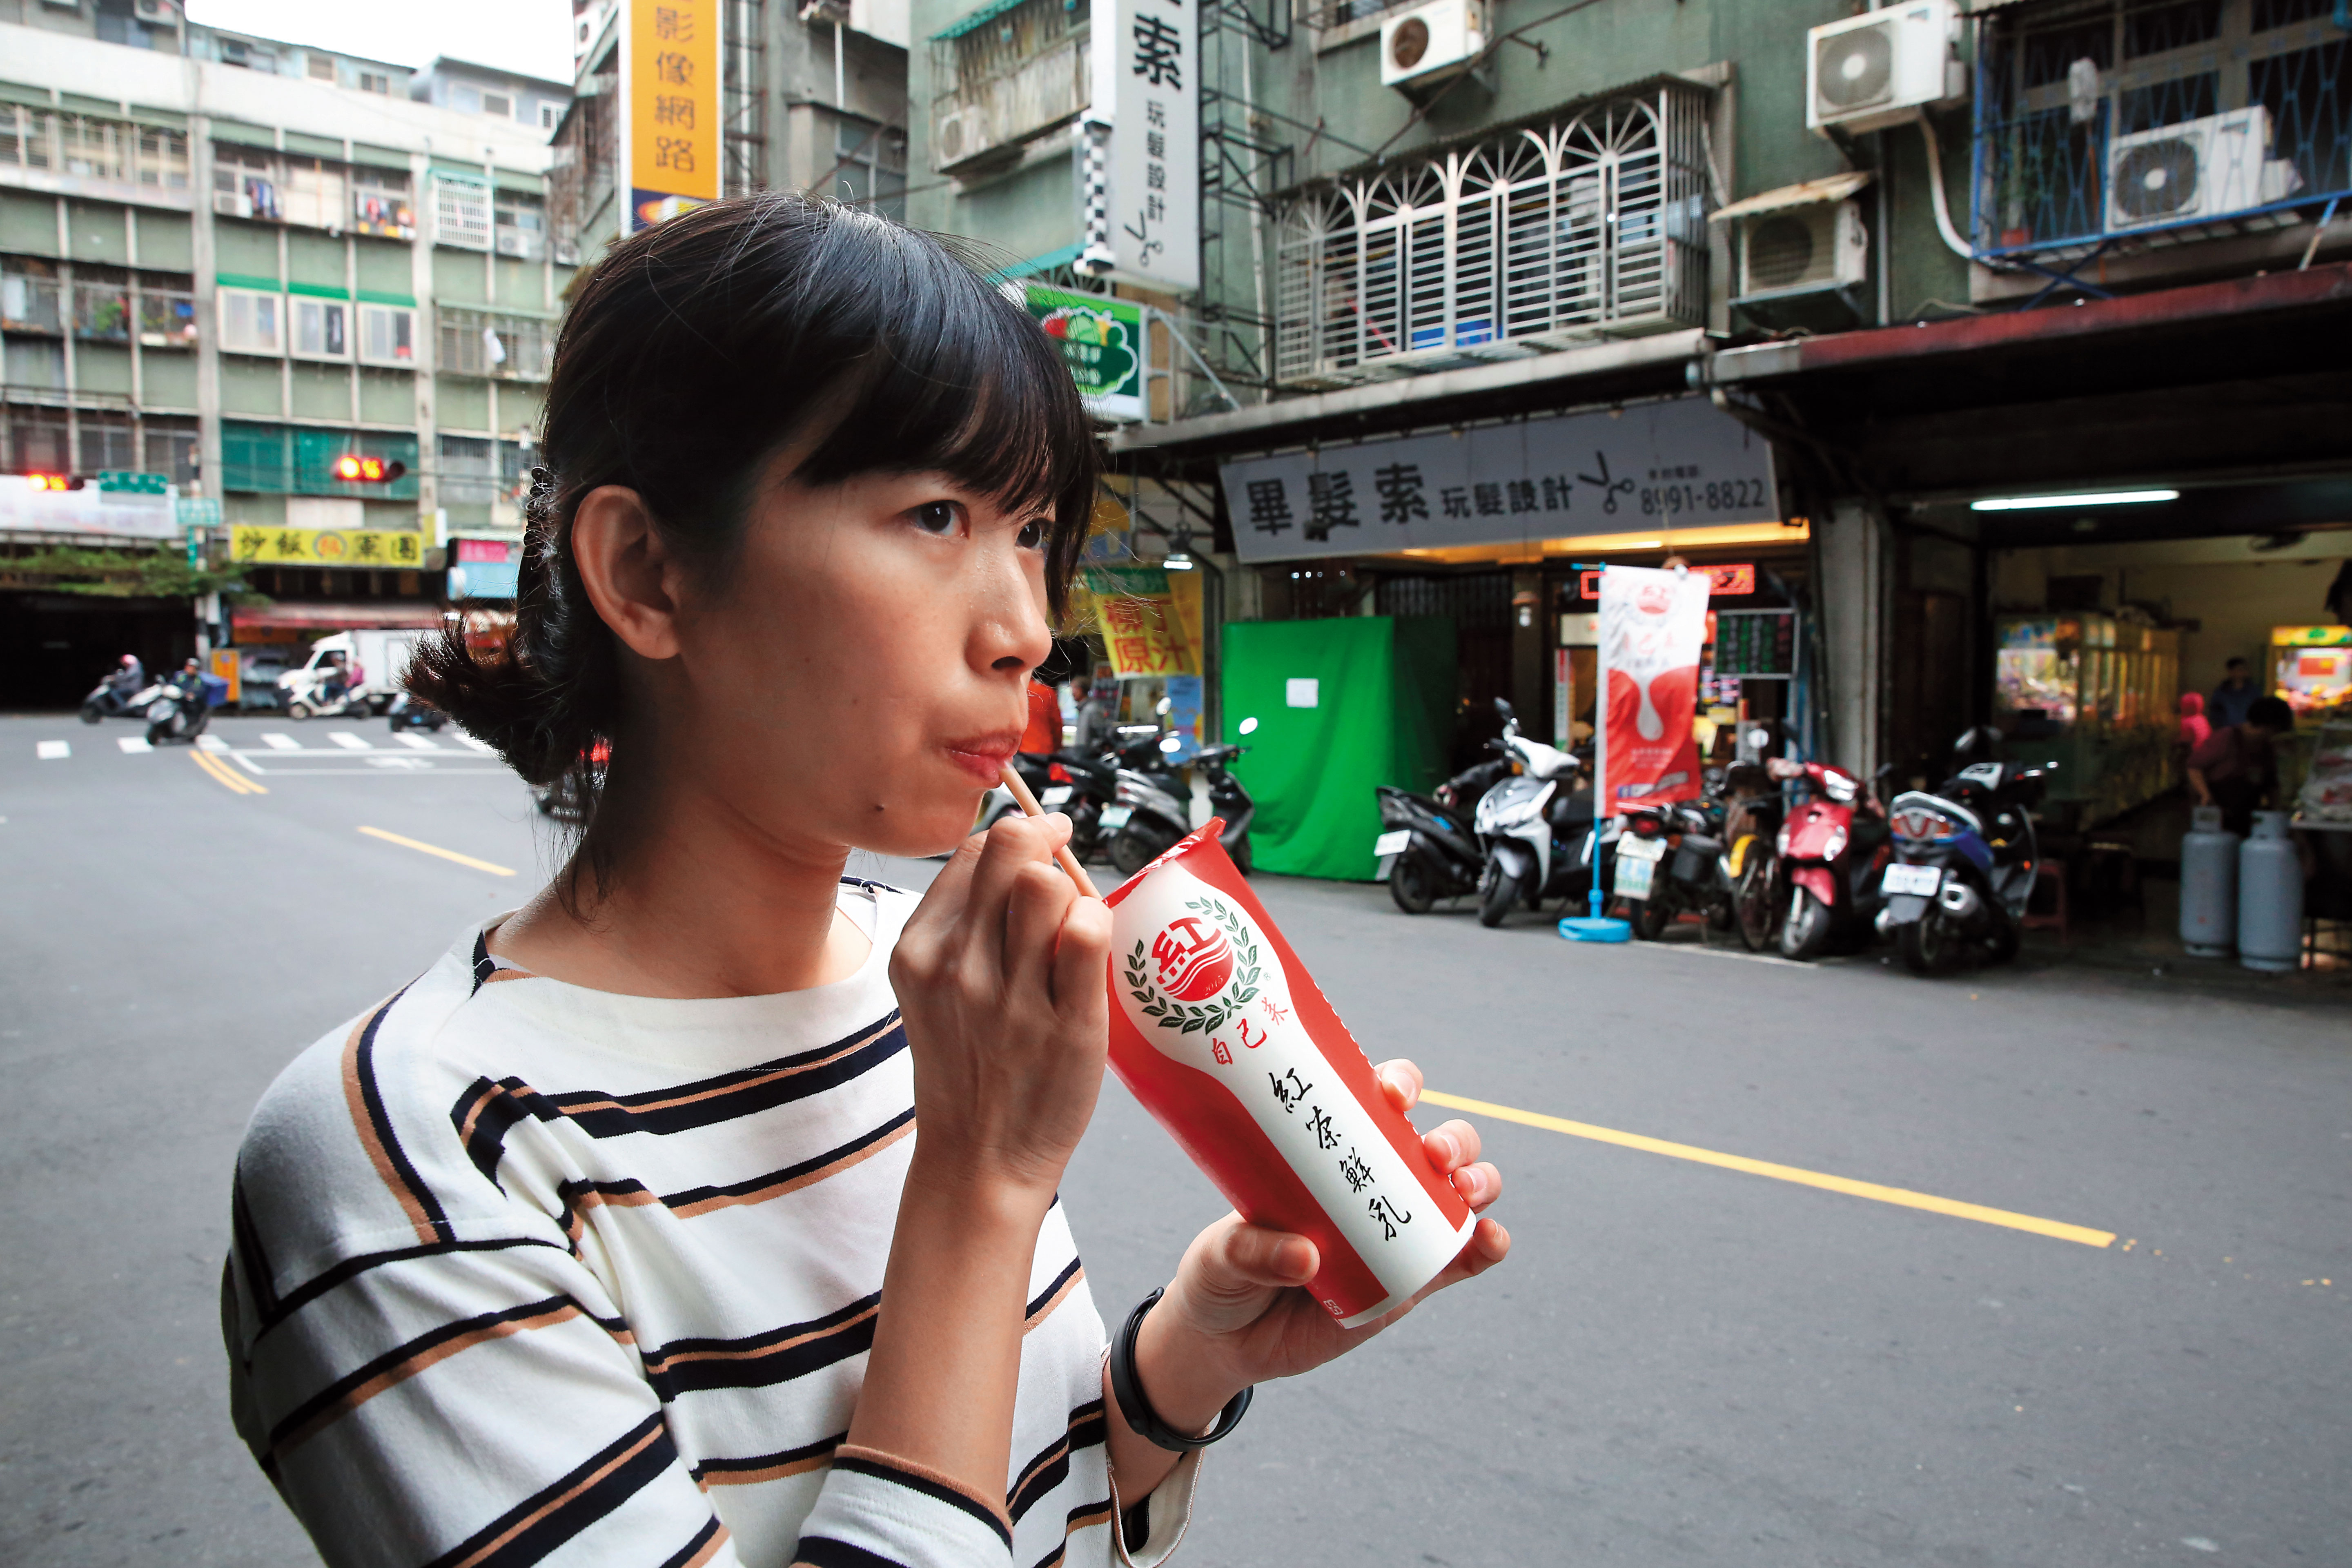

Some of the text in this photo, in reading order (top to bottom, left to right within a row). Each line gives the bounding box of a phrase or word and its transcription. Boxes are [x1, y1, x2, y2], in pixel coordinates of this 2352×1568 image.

[1133, 0, 1181, 90] 索
[1115, 636, 1186, 673] 原汁
[1203, 975, 1223, 996] 2015
[1269, 1067, 1412, 1241] 紅茶鮮乳
